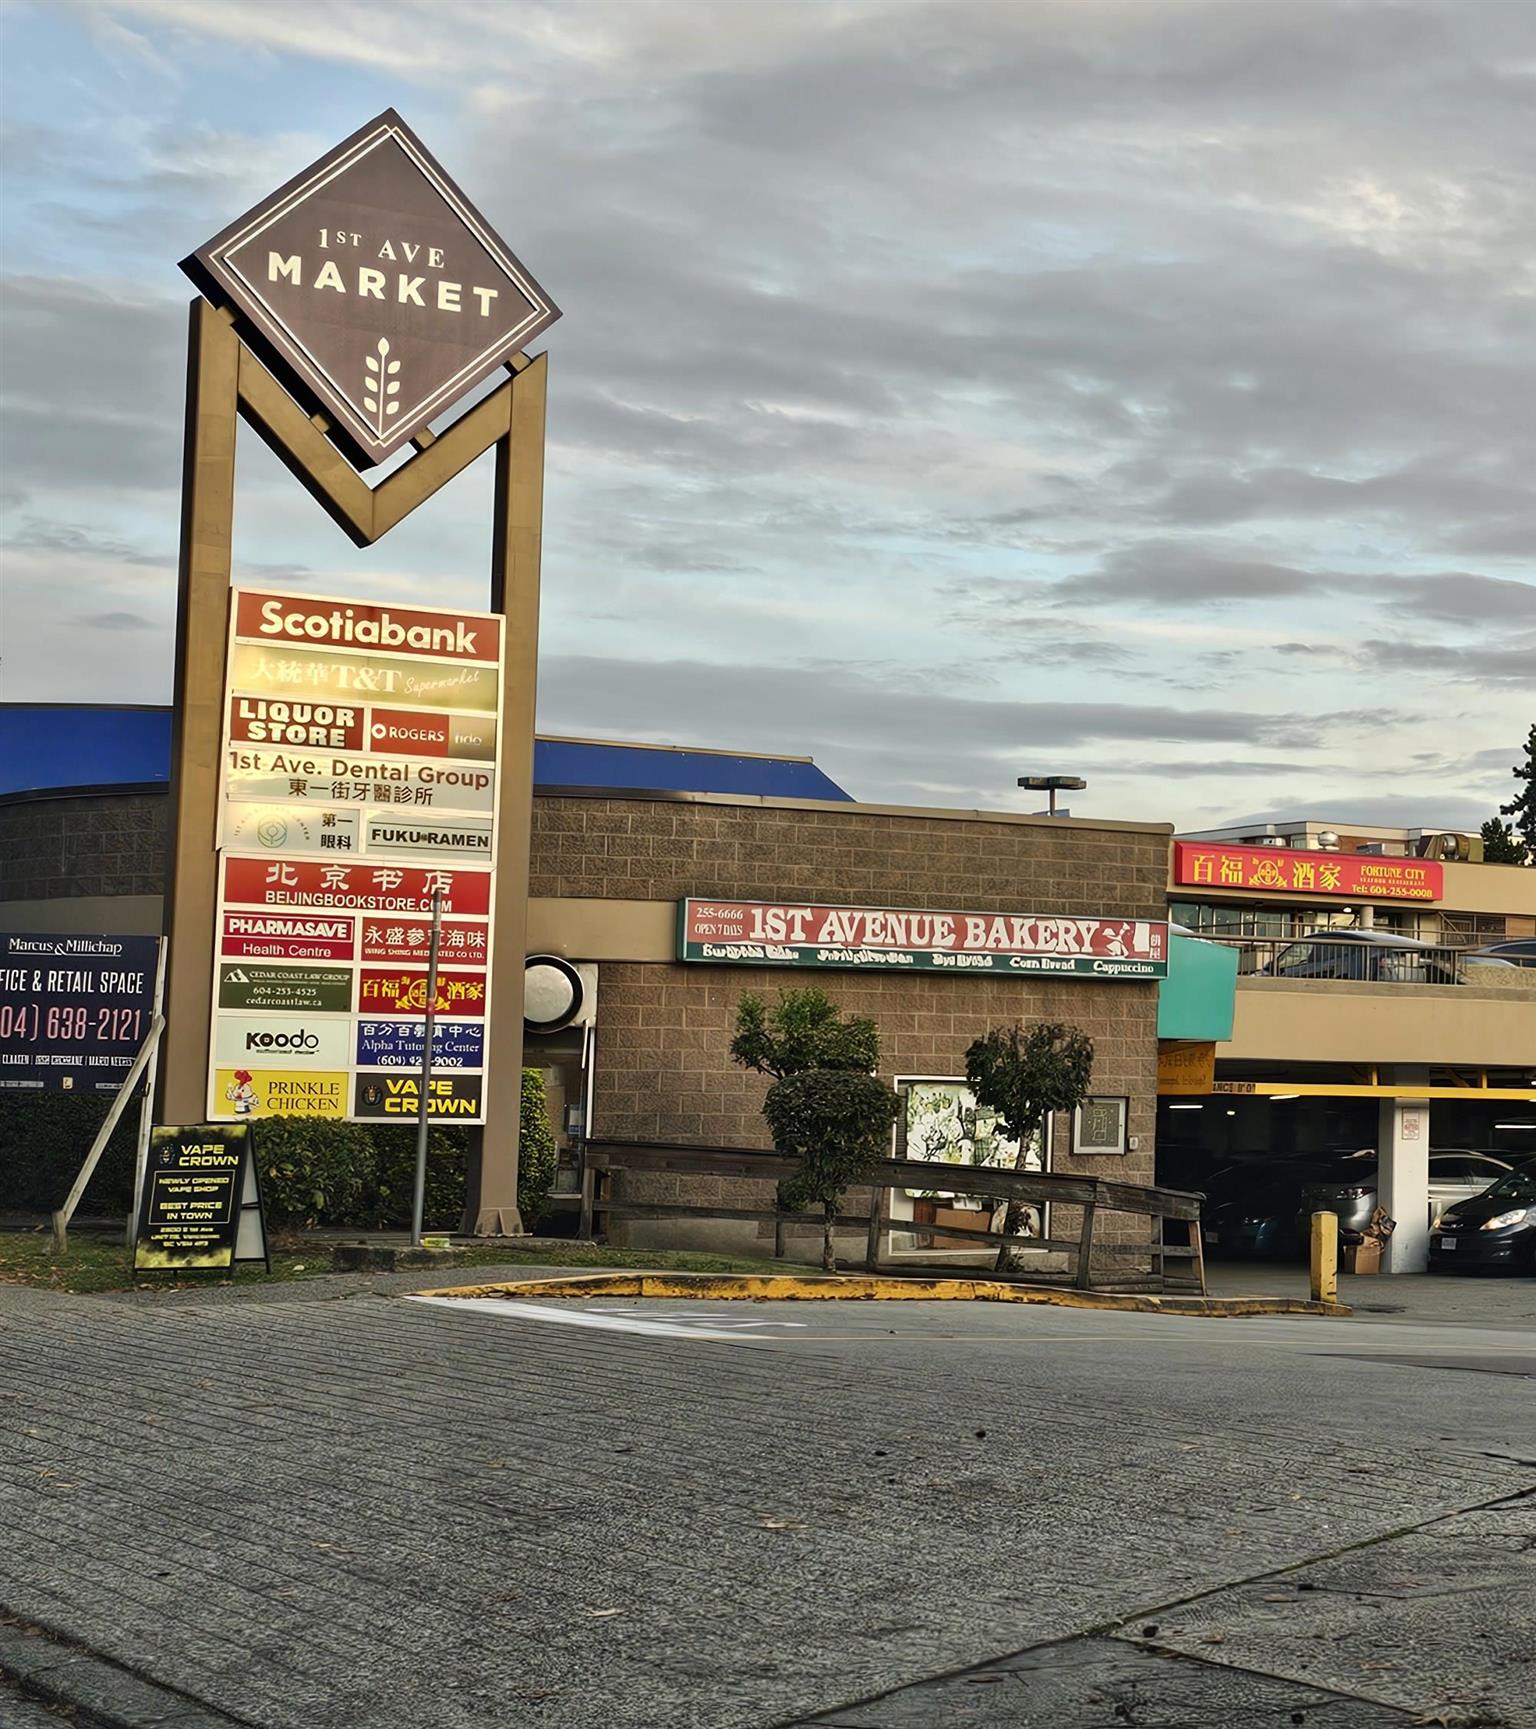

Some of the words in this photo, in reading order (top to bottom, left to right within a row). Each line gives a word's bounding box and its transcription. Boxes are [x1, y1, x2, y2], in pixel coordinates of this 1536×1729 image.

[319, 228, 361, 250] 1ST
[378, 239, 445, 269] AVE
[268, 251, 498, 317] MARKET
[260, 600, 478, 654] Scotiabank
[330, 664, 402, 693] T&T
[404, 668, 480, 697] Supermarket
[240, 699, 355, 727] LIQUOR
[247, 720, 346, 747] STORE
[389, 726, 445, 742] ROGERS
[229, 751, 261, 770] 1st
[270, 755, 322, 775] Ave.
[332, 759, 409, 782] Dental
[418, 767, 490, 791] Group
[288, 778, 433, 806] 東一街牙醫診所
[320, 834, 351, 850] 眼科
[372, 829, 420, 843] FUKU
[427, 832, 489, 847] RAMEN
[265, 863, 454, 895] 北京书店
[1192, 855, 1243, 884] 百福
[1293, 860, 1342, 890] 酒家
[1361, 865, 1402, 878] FORTUNE
[1405, 868, 1426, 880] CITY
[228, 918, 347, 938] PHARMASAVE
[696, 907, 743, 920] 255-6666
[750, 908, 814, 941] 1ST
[817, 911, 956, 947] AVENUE
[963, 917, 1100, 953] BAKERY
[9, 938, 53, 951] Marcus
[66, 940, 122, 955] Millichap
[242, 942, 284, 955] Health
[288, 944, 332, 957] Centre
[249, 970, 275, 978] CEDAR
[277, 972, 303, 980] COAST
[1093, 960, 1154, 974] Cappuccino
[32, 970, 42, 991] &
[47, 970, 94, 993] RETAIL
[100, 972, 144, 994] SPACE
[361, 978, 400, 998] 百福
[448, 981, 484, 1000] 酒家
[246, 996, 322, 1006] cedarcoastlaw.ca
[47, 1006, 141, 1040] 638-2121
[361, 1040, 393, 1053] Alpha
[445, 1041, 480, 1052] Center
[409, 1056, 463, 1067] 42-9002
[268, 1082, 340, 1095] PRINKLE
[267, 1098, 338, 1110] CHICKEN
[181, 1144, 225, 1155] VAPE
[179, 1156, 239, 1166] CROWN
